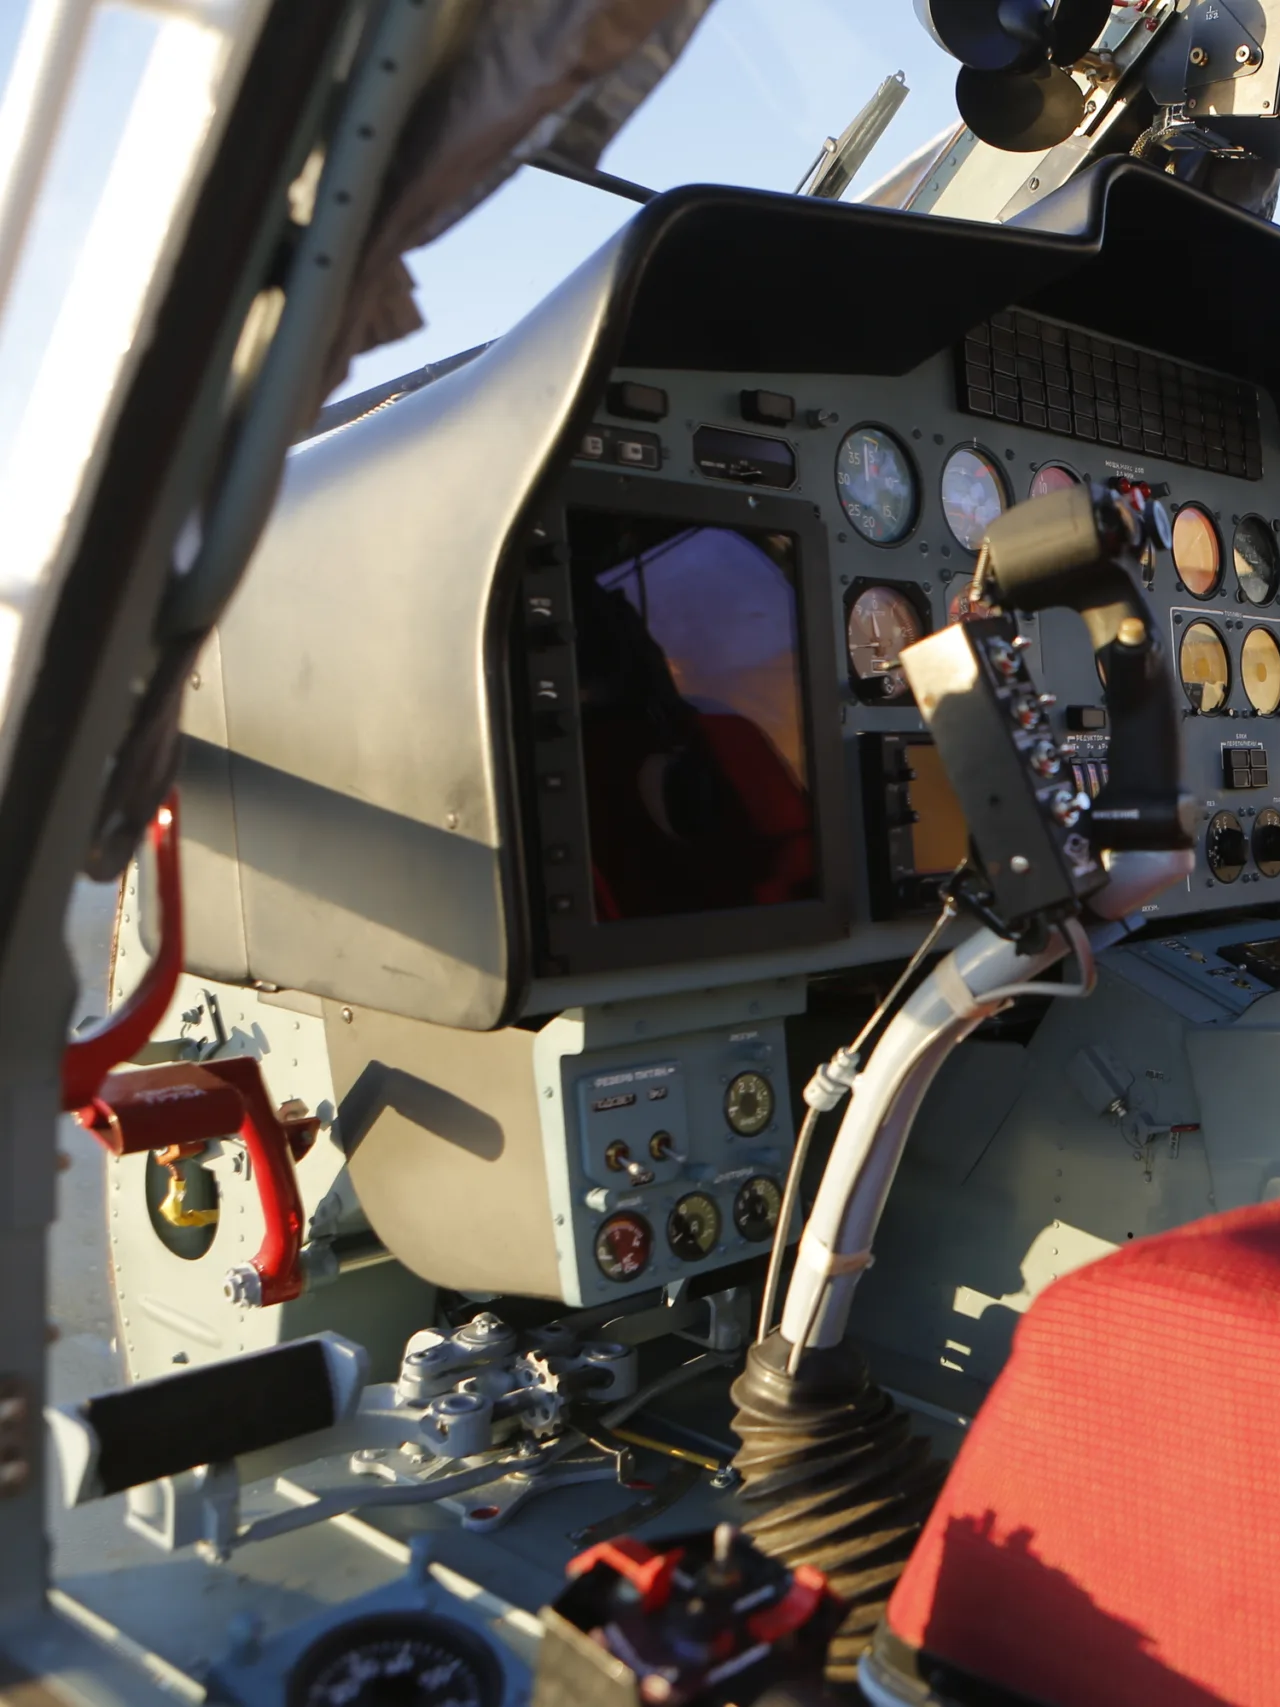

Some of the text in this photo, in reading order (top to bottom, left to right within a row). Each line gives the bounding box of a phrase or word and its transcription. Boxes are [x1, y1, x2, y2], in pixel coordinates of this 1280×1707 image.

[848, 452, 860, 465] 35
[838, 472, 850, 486] 30
[848, 504, 861, 517] 25
[863, 516, 875, 528] 20
